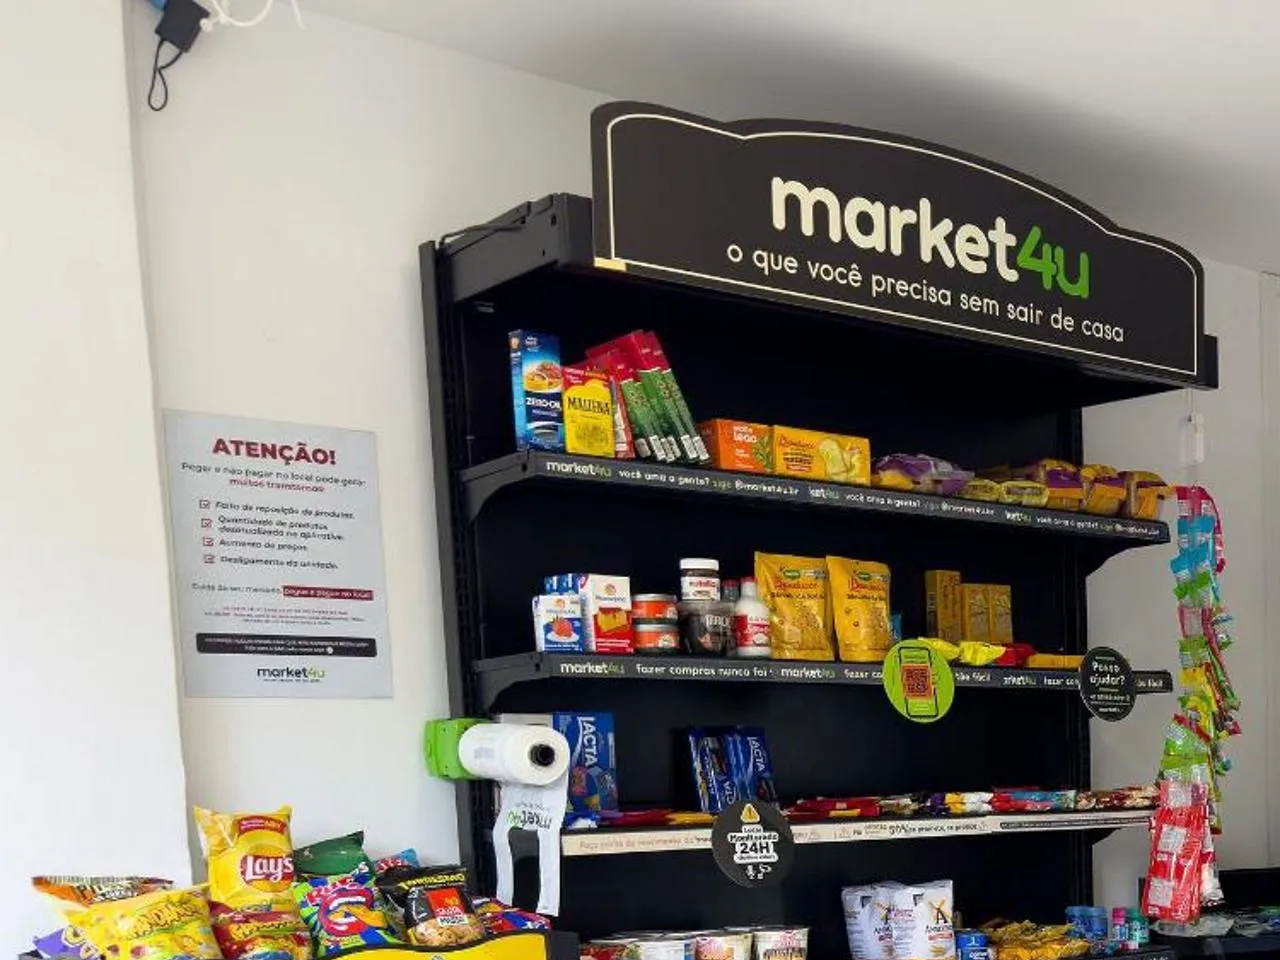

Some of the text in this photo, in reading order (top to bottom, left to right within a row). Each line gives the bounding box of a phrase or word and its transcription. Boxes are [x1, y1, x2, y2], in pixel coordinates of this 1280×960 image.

[771, 176, 1091, 299] market4u
[726, 244, 1125, 342] o que você precisa sem sair de casa
[212, 438, 337, 466] ATENÇÃO!
[546, 460, 613, 478] market4u
[256, 667, 325, 679] market4u
[560, 662, 625, 675] market4u
[636, 664, 666, 674] fazer
[669, 666, 716, 677] compras
[719, 669, 750, 677] nunca
[1089, 673, 1126, 687] ajudar?
[577, 716, 599, 767] LACTA
[747, 736, 766, 773] LACTA
[740, 842, 770, 854] 24H
[244, 854, 294, 882] Lay's
